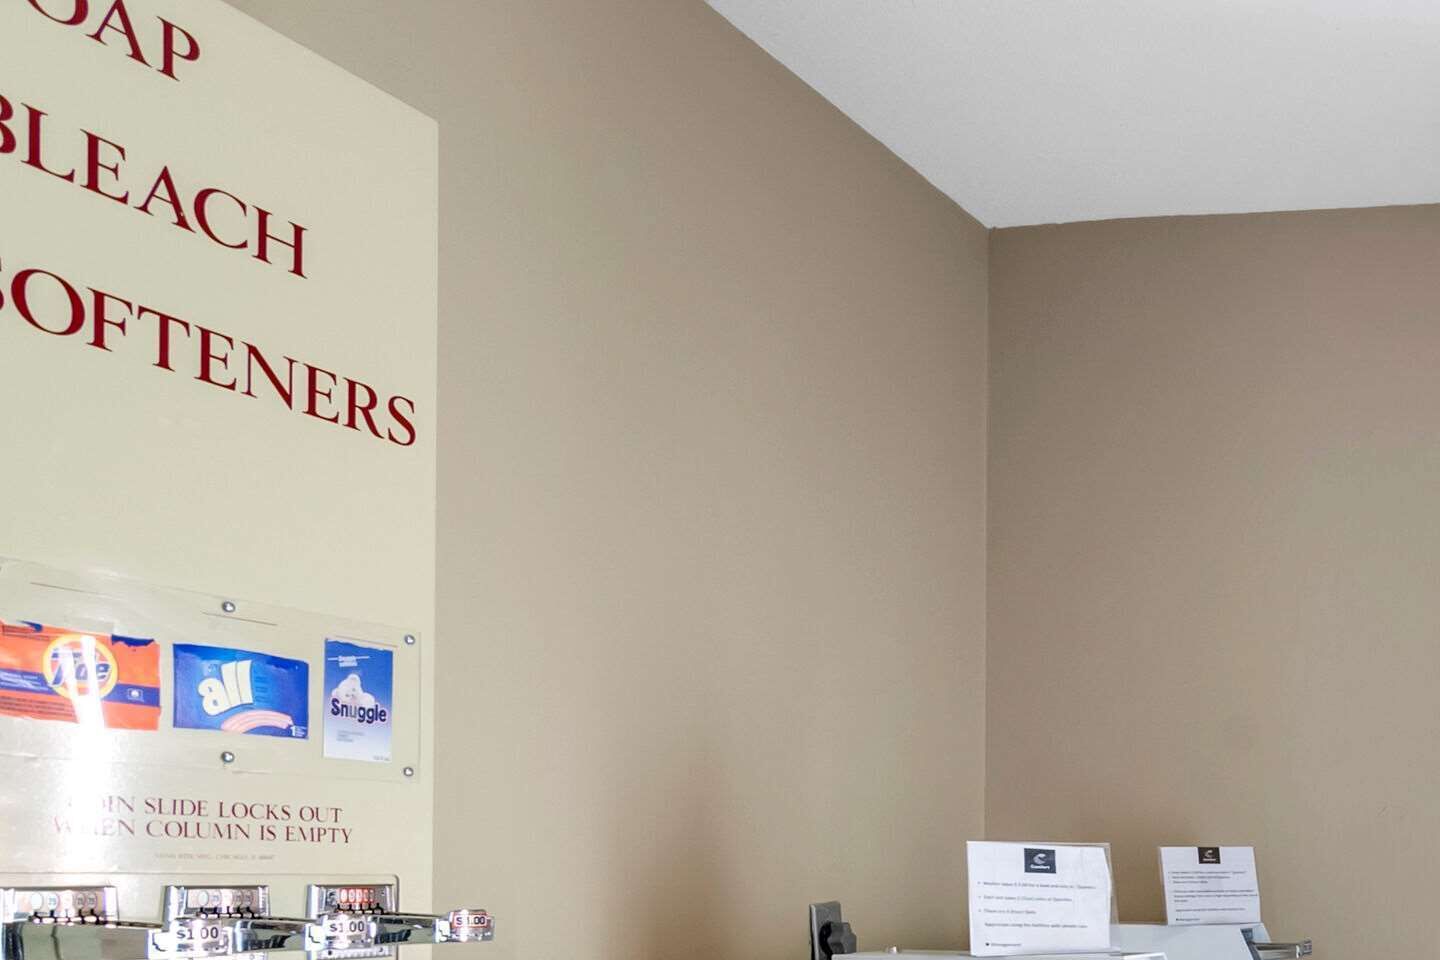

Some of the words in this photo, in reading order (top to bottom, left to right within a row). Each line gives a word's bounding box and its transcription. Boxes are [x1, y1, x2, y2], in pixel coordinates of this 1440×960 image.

[0, 256, 417, 447] OFTENERS
[198, 659, 253, 715] all
[331, 698, 387, 724] Snuggle
[144, 797, 209, 817] SLIDE
[218, 800, 291, 822] LOCKS
[299, 804, 342, 823] OUT
[146, 819, 251, 841] COLUMN
[260, 824, 277, 842] IS
[285, 825, 353, 844] EMPTY
